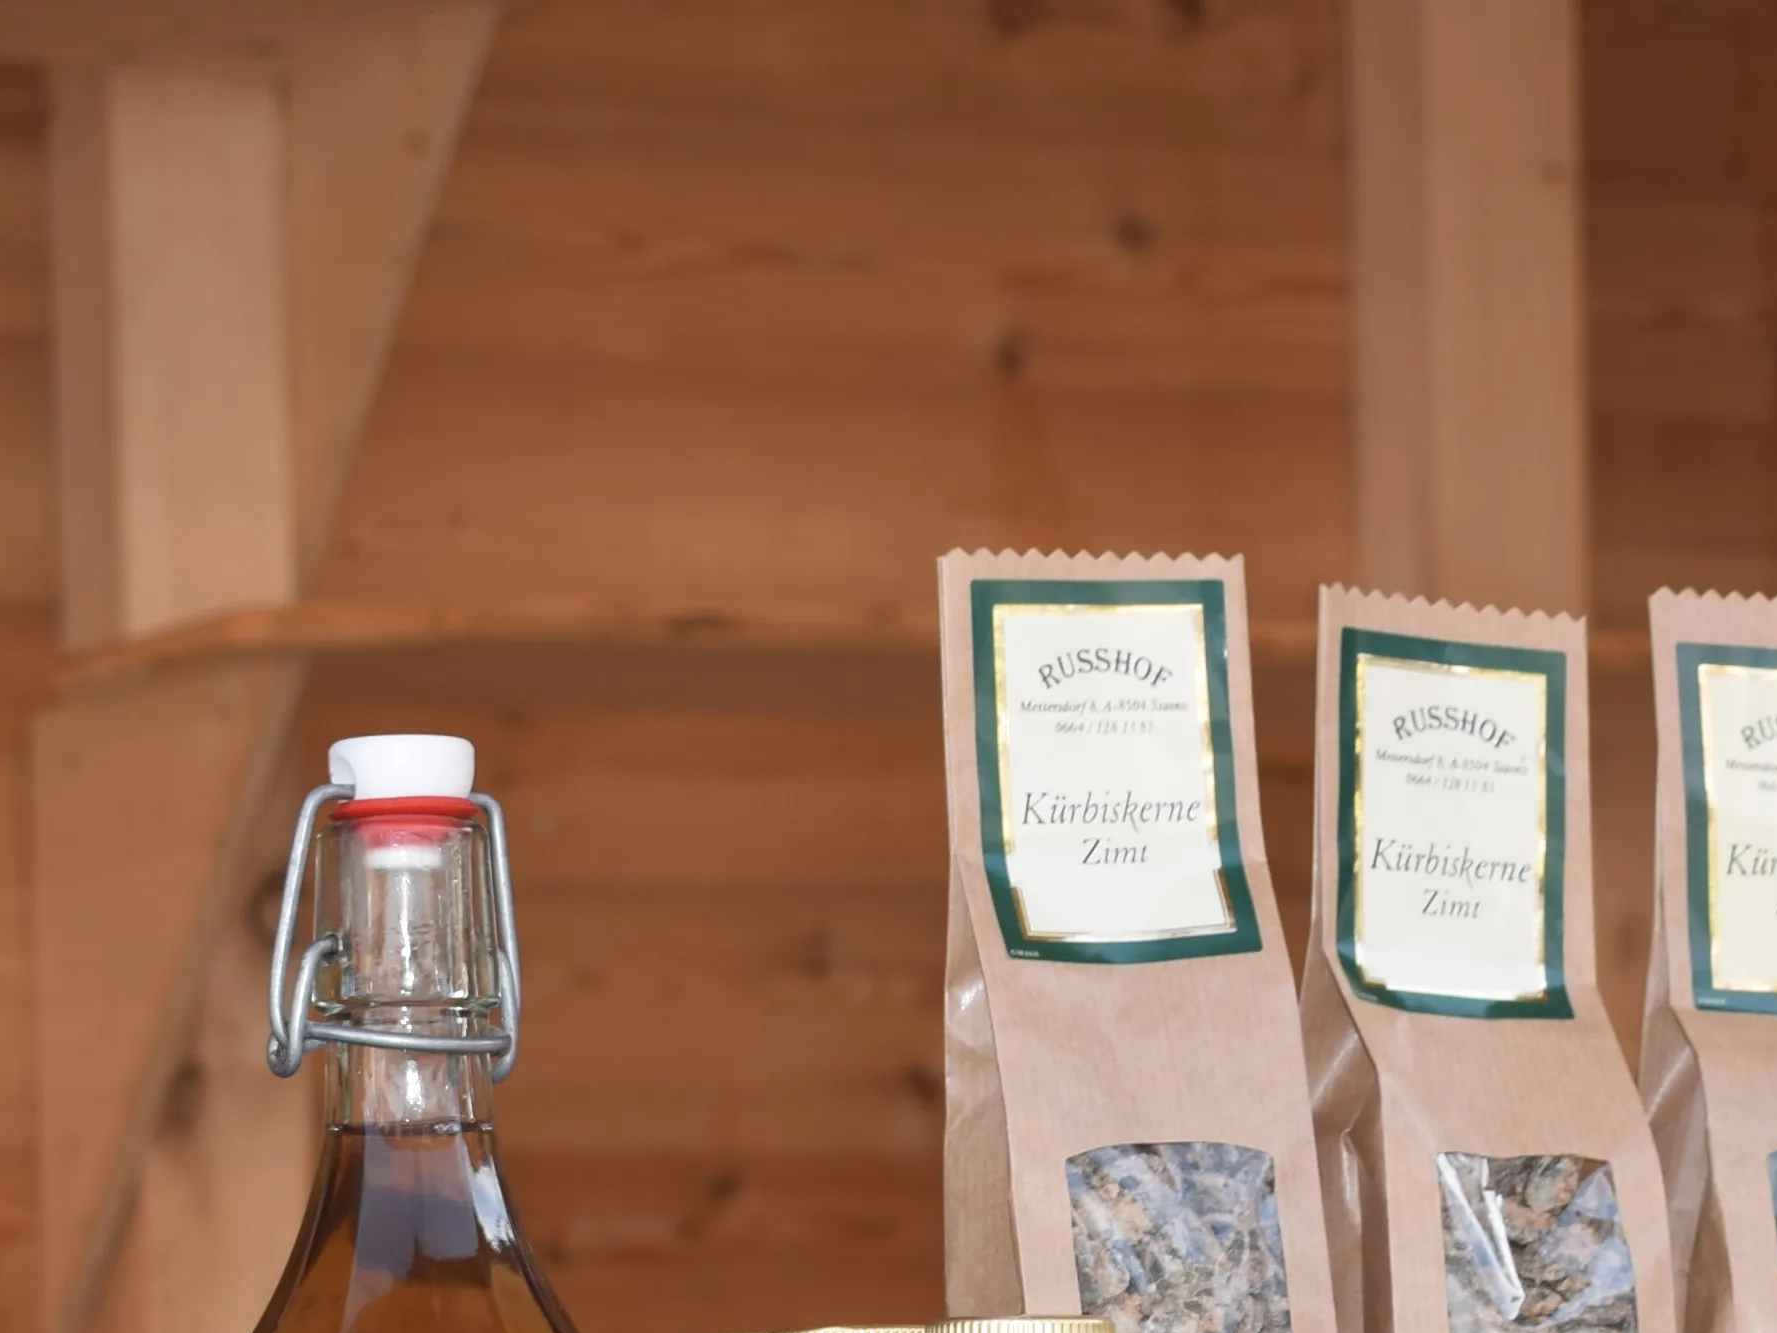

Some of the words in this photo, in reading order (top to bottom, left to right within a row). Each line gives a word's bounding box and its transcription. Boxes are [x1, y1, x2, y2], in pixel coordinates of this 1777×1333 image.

[1038, 648, 1173, 689] RUSSHOF
[1393, 706, 1516, 748] RUSSHOF
[1022, 791, 1201, 832] Kürbiskerne
[1082, 838, 1149, 866] Zimt
[1370, 838, 1531, 889] Kürbiskerne
[1421, 887, 1482, 919] Zimt
